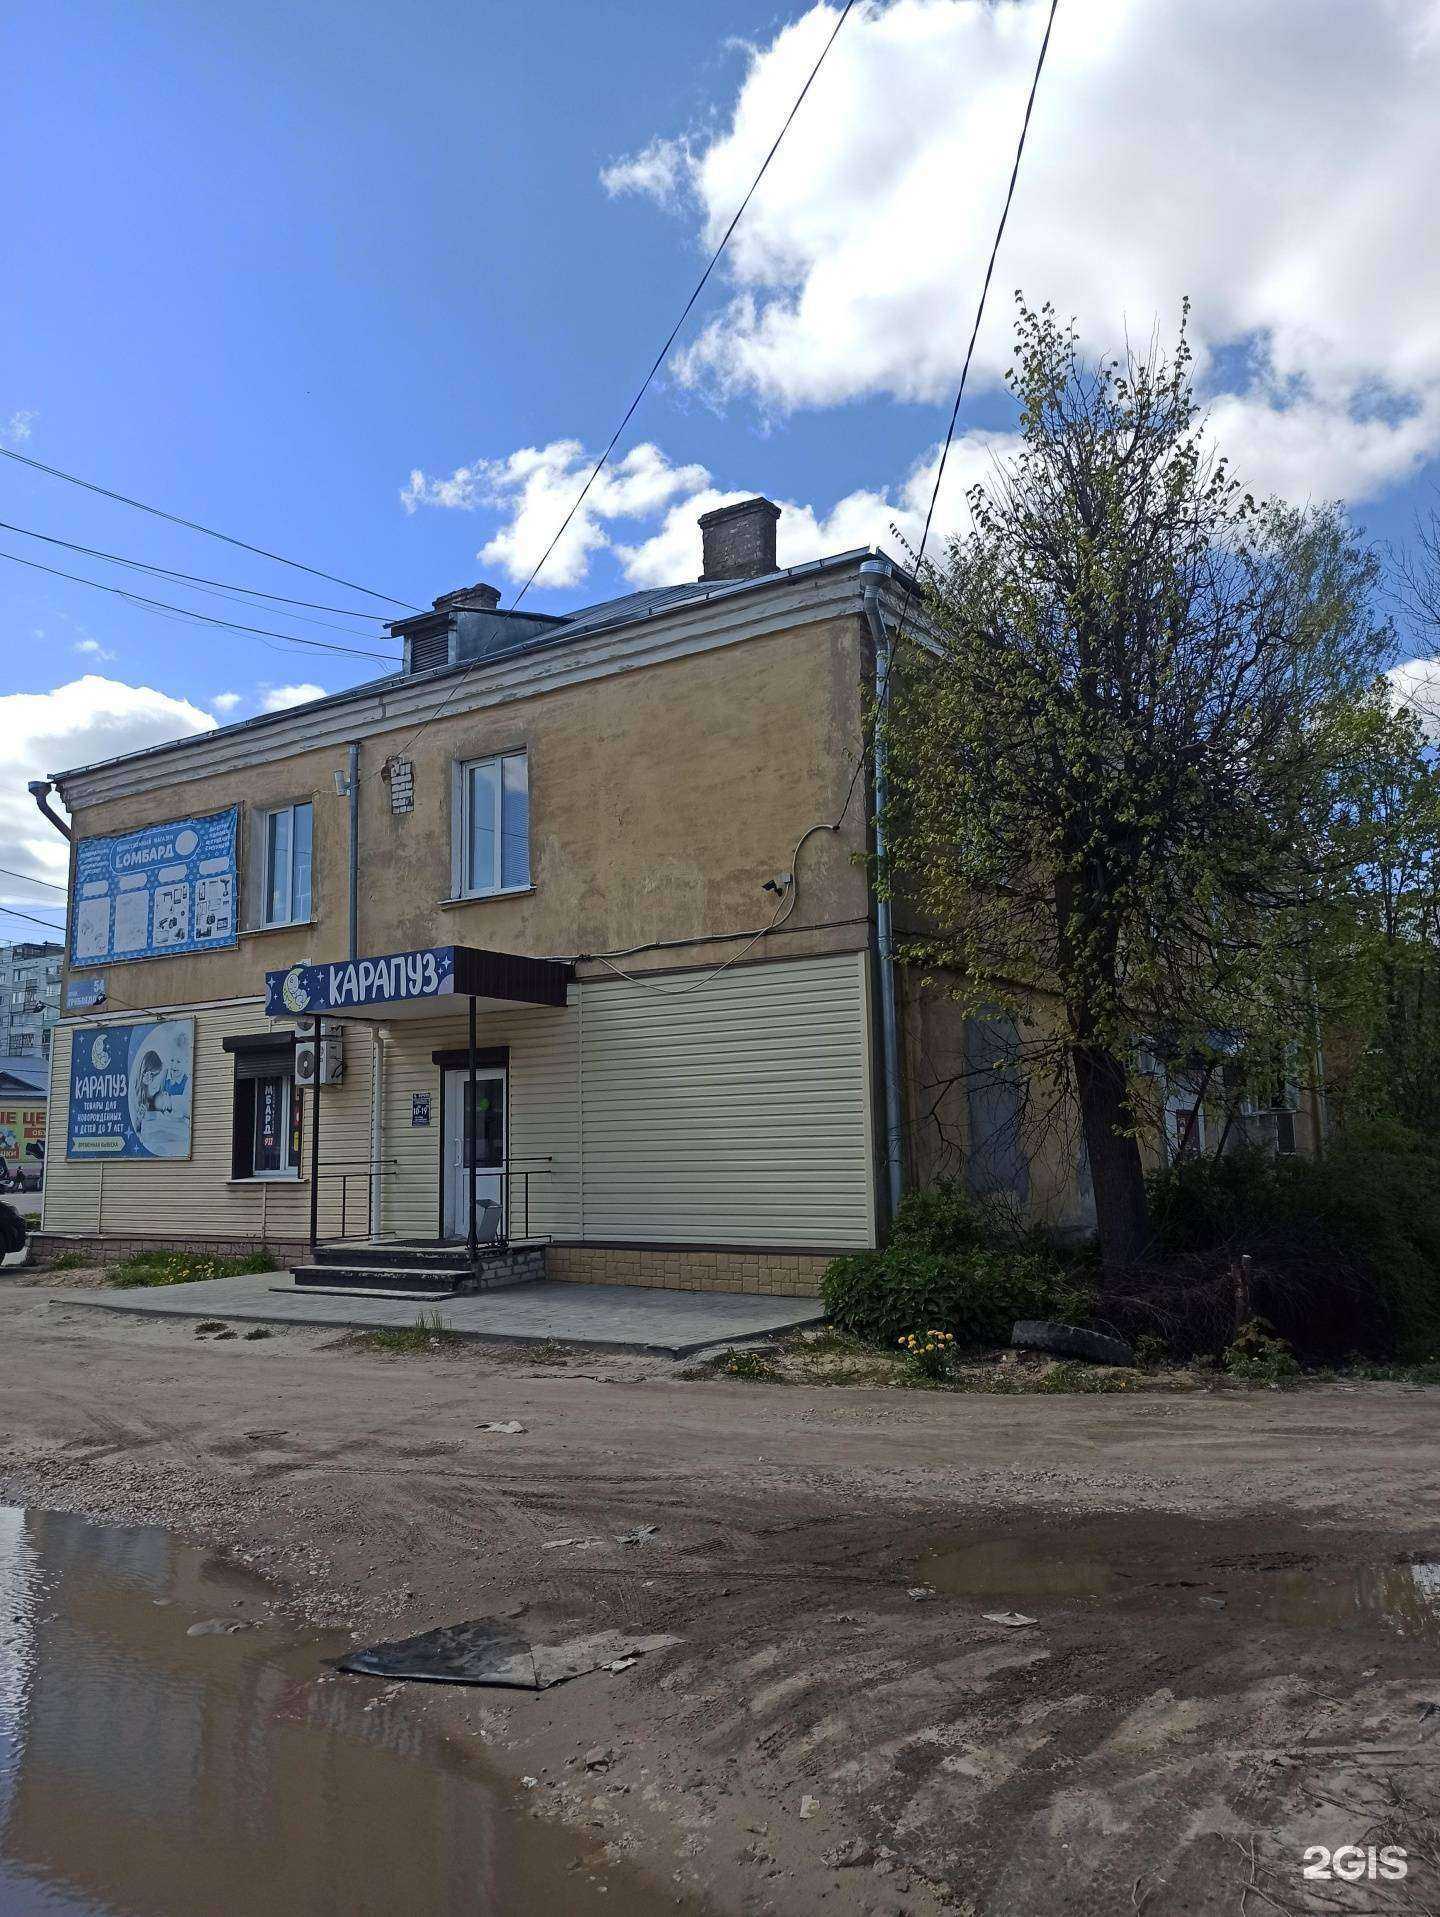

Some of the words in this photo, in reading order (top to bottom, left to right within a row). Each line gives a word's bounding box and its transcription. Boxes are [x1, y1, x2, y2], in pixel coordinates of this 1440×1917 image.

[329, 953, 439, 1006] КАРАПУЗ
[75, 1074, 128, 1099] КАРАПУЗ
[84, 1101, 104, 1110] ТОВАРЫ
[105, 1100, 117, 1111] ДЛЯ
[74, 1125, 79, 1133] И
[80, 1123, 96, 1134] ДЕТЕЙ
[98, 1124, 106, 1134] ДО
[107, 1122, 113, 1133] 7
[113, 1123, 124, 1132] ЛЕТ
